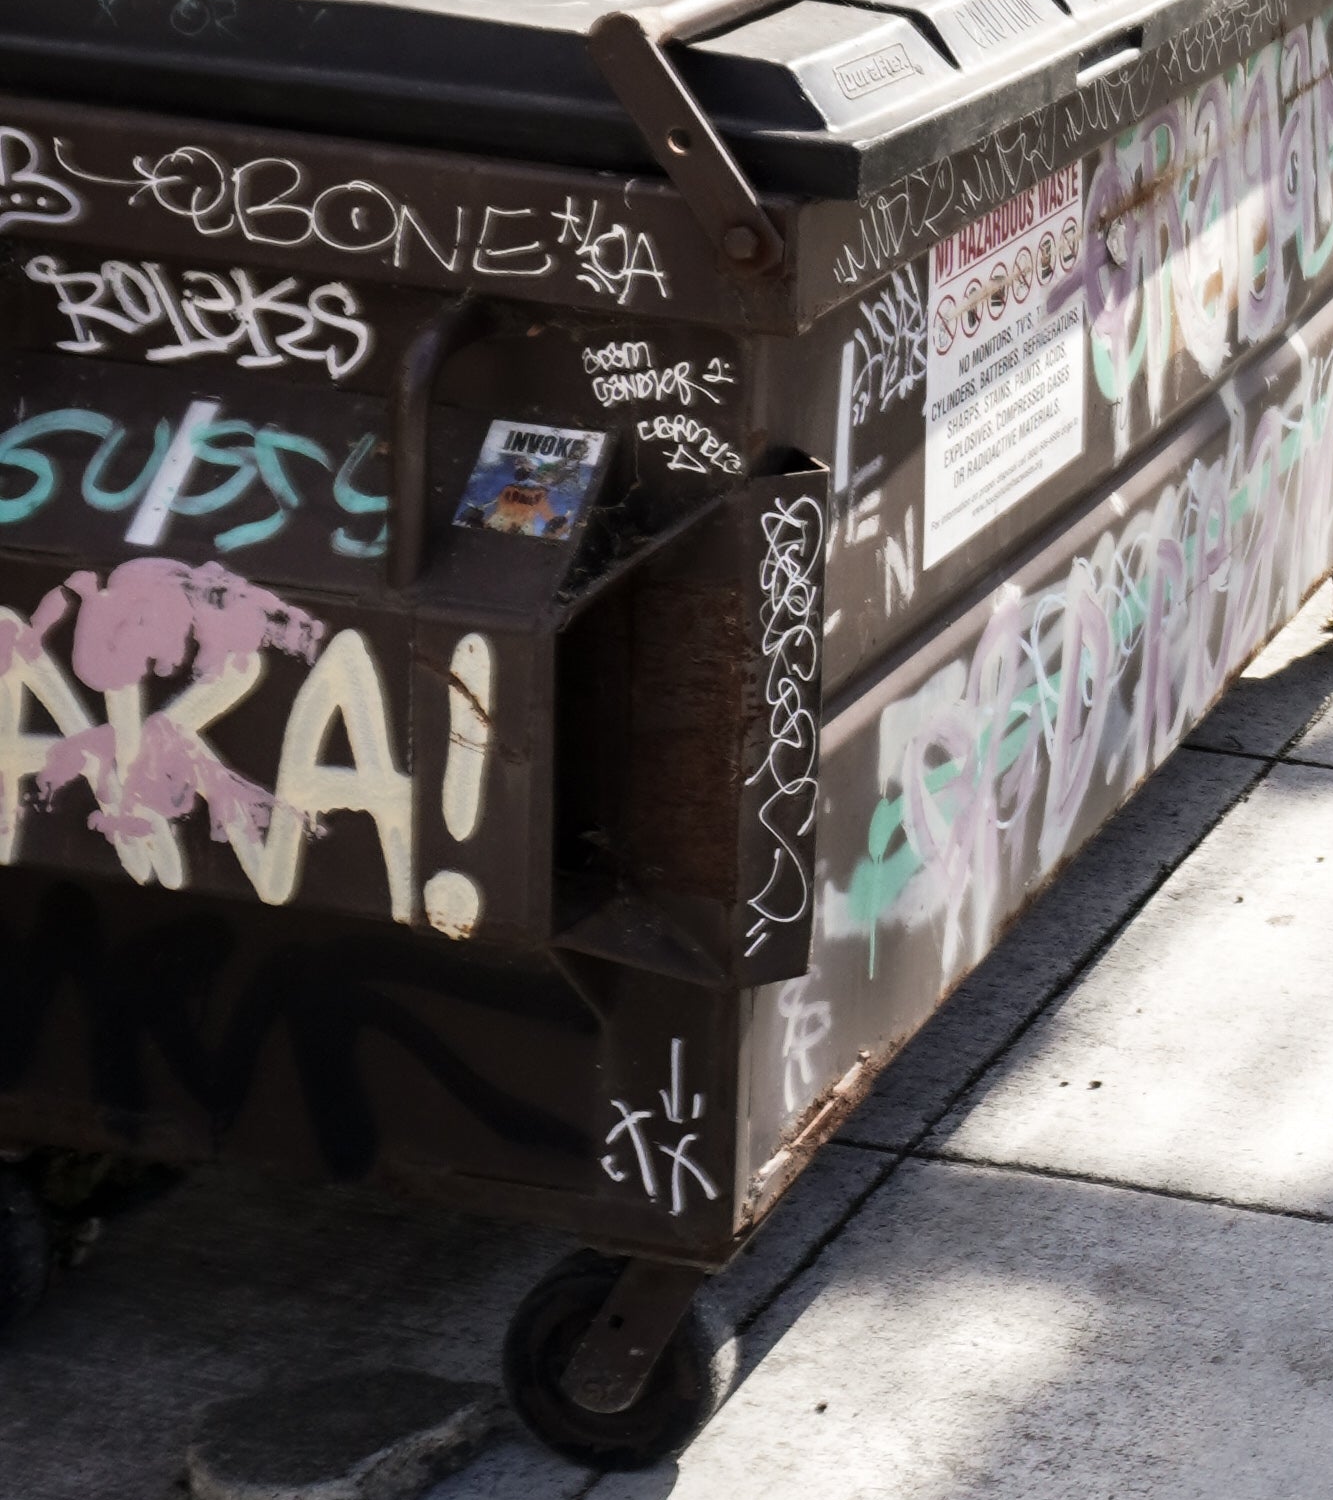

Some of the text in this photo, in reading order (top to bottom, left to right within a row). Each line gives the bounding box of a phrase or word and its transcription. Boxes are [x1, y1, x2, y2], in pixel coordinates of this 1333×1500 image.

[935, 237, 954, 284] NO
[959, 188, 1034, 269] HAZARDOUS
[1038, 162, 1078, 220] WASTE
[959, 354, 970, 377] NO
[996, 380, 1047, 428] COMPRESSED
[954, 466, 965, 489] OR
[967, 427, 1017, 479] RADIOACTIVE
